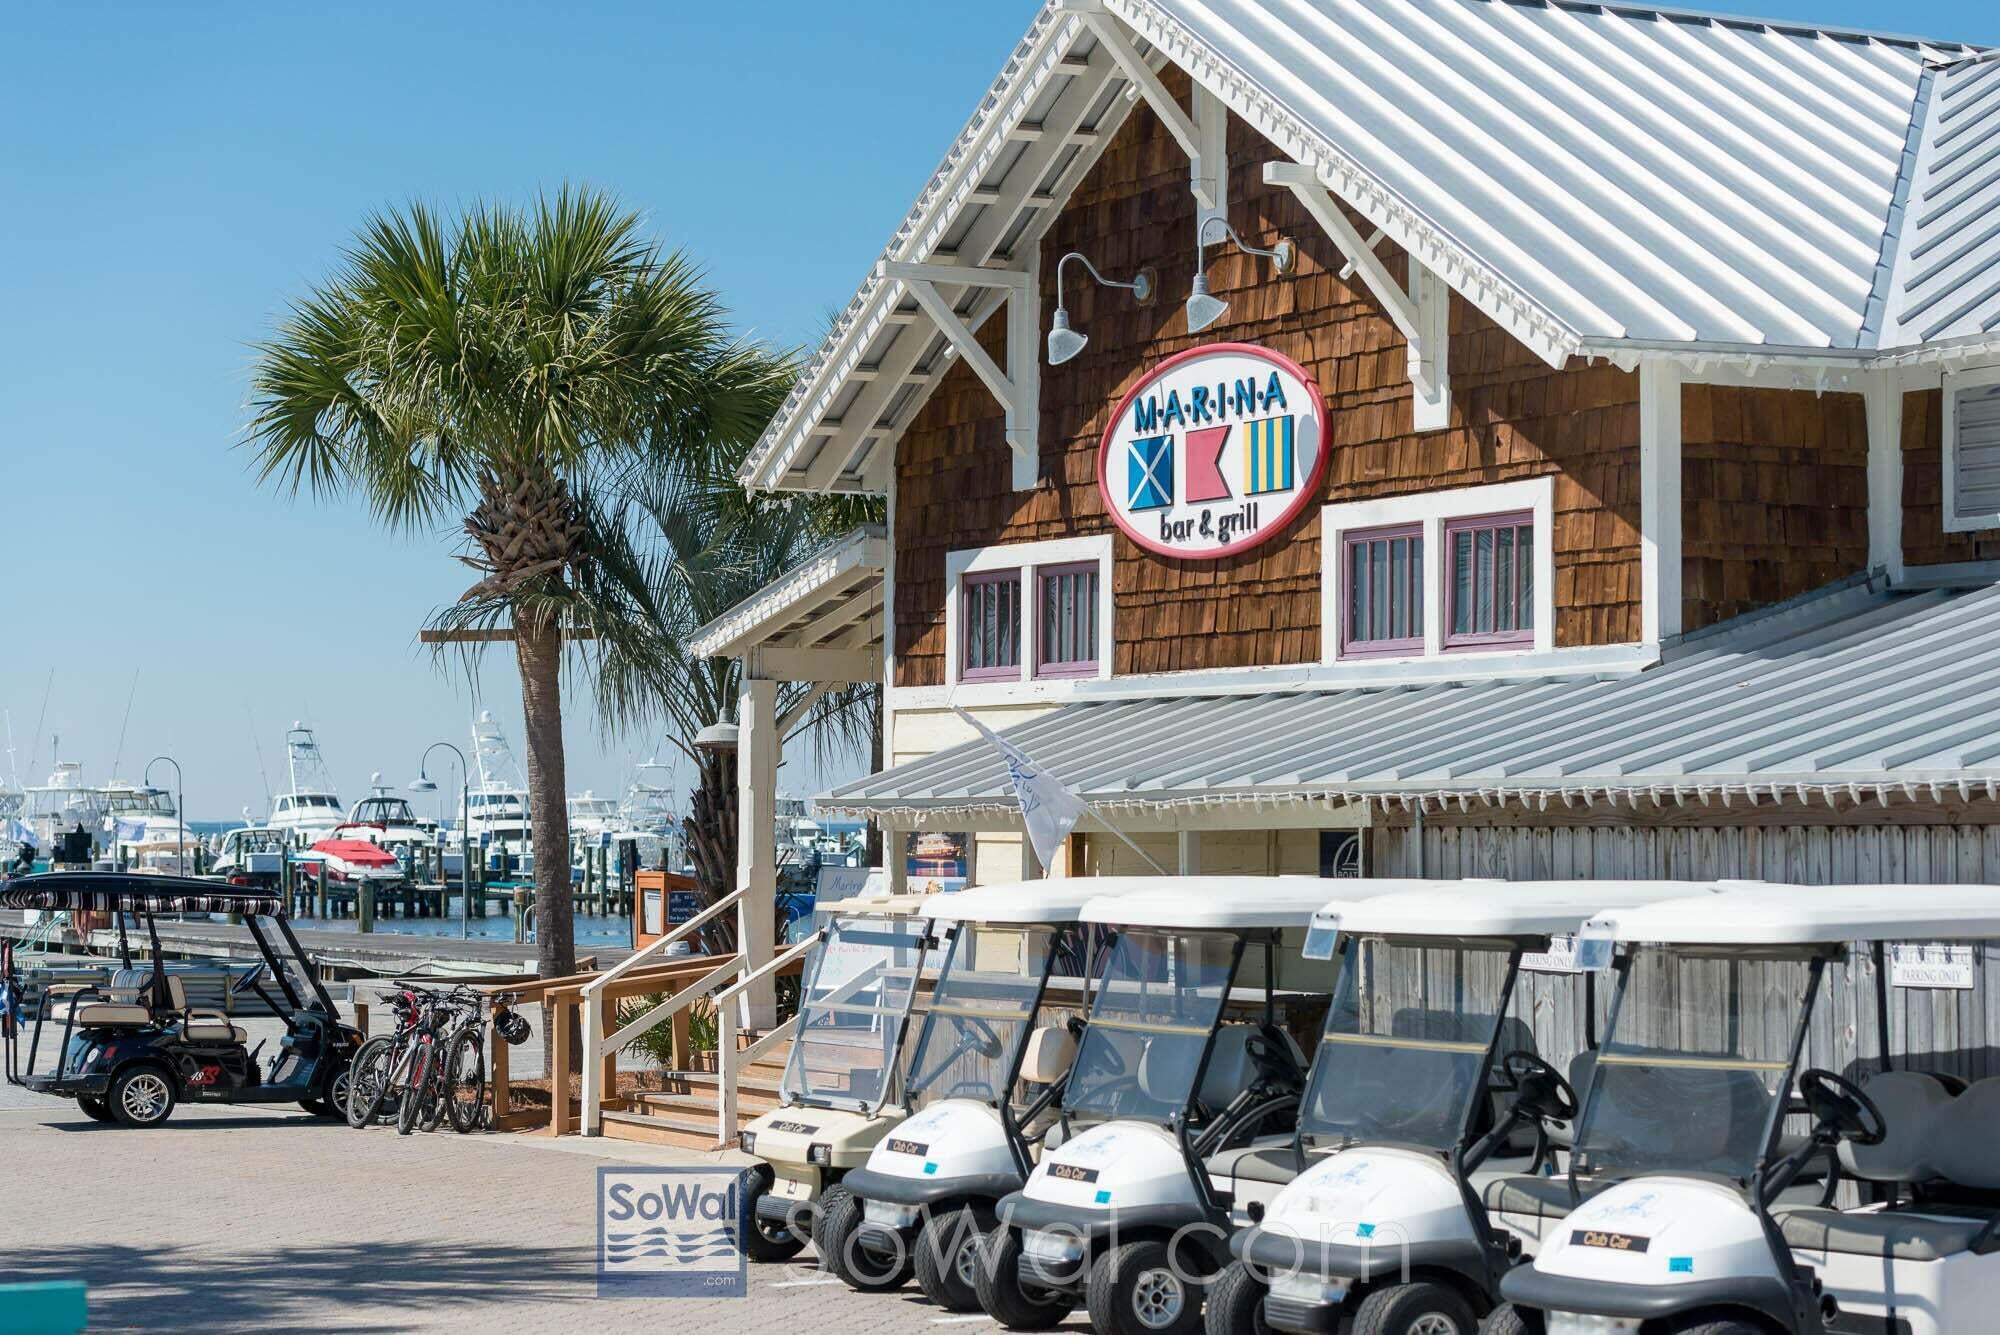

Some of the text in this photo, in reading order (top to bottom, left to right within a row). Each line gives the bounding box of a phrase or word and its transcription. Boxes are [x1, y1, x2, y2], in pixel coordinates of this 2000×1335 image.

[1160, 502, 1259, 543] bar & grill
[893, 1140, 919, 1154] Club Car
[1055, 1165, 1087, 1180] Club Car
[1583, 1231, 1632, 1249] Club Car
